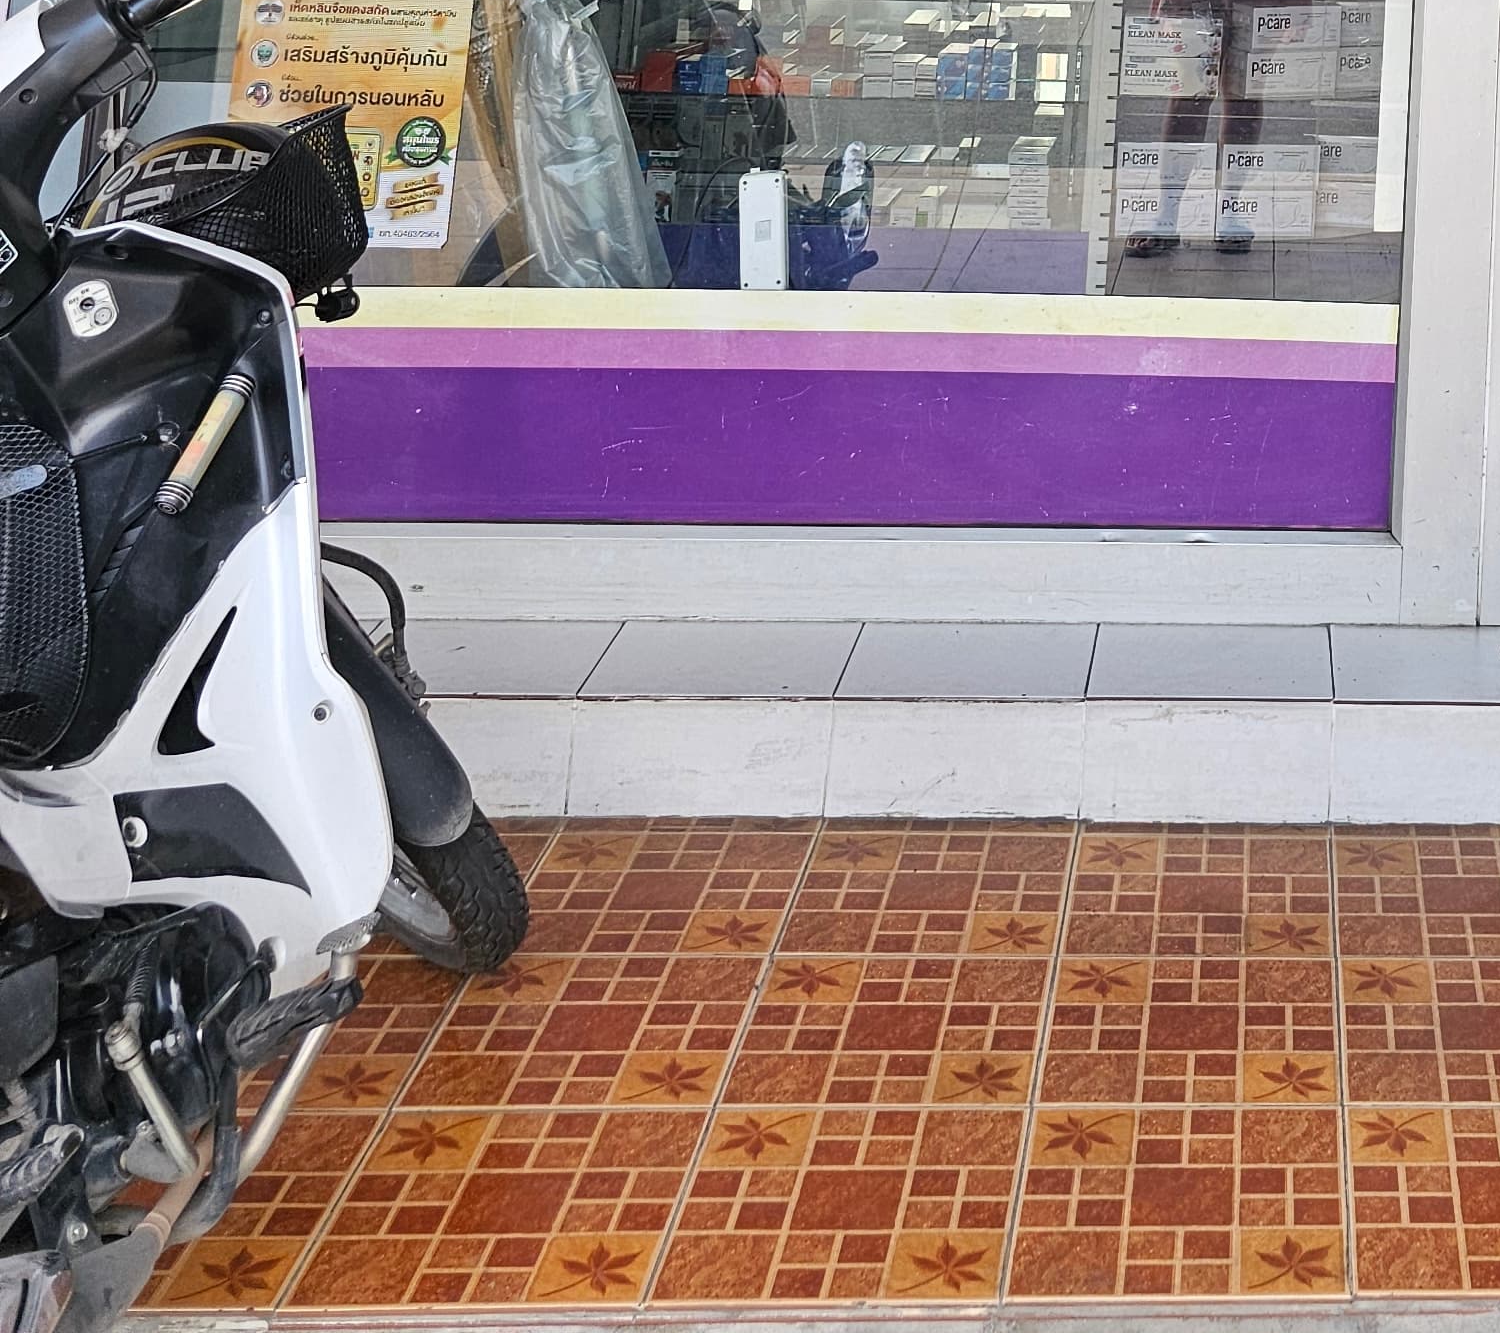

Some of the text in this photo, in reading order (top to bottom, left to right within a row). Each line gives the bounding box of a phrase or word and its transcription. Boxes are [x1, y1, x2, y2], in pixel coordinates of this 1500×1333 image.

[1127, 29, 1182, 39] KLEAN MASK
[283, 44, 448, 72] เสริมสร้างภูมิคุ้มกัน
[1124, 68, 1179, 78] KLEAN MASK
[279, 84, 445, 108] ช่วยในการนอนหลับ
